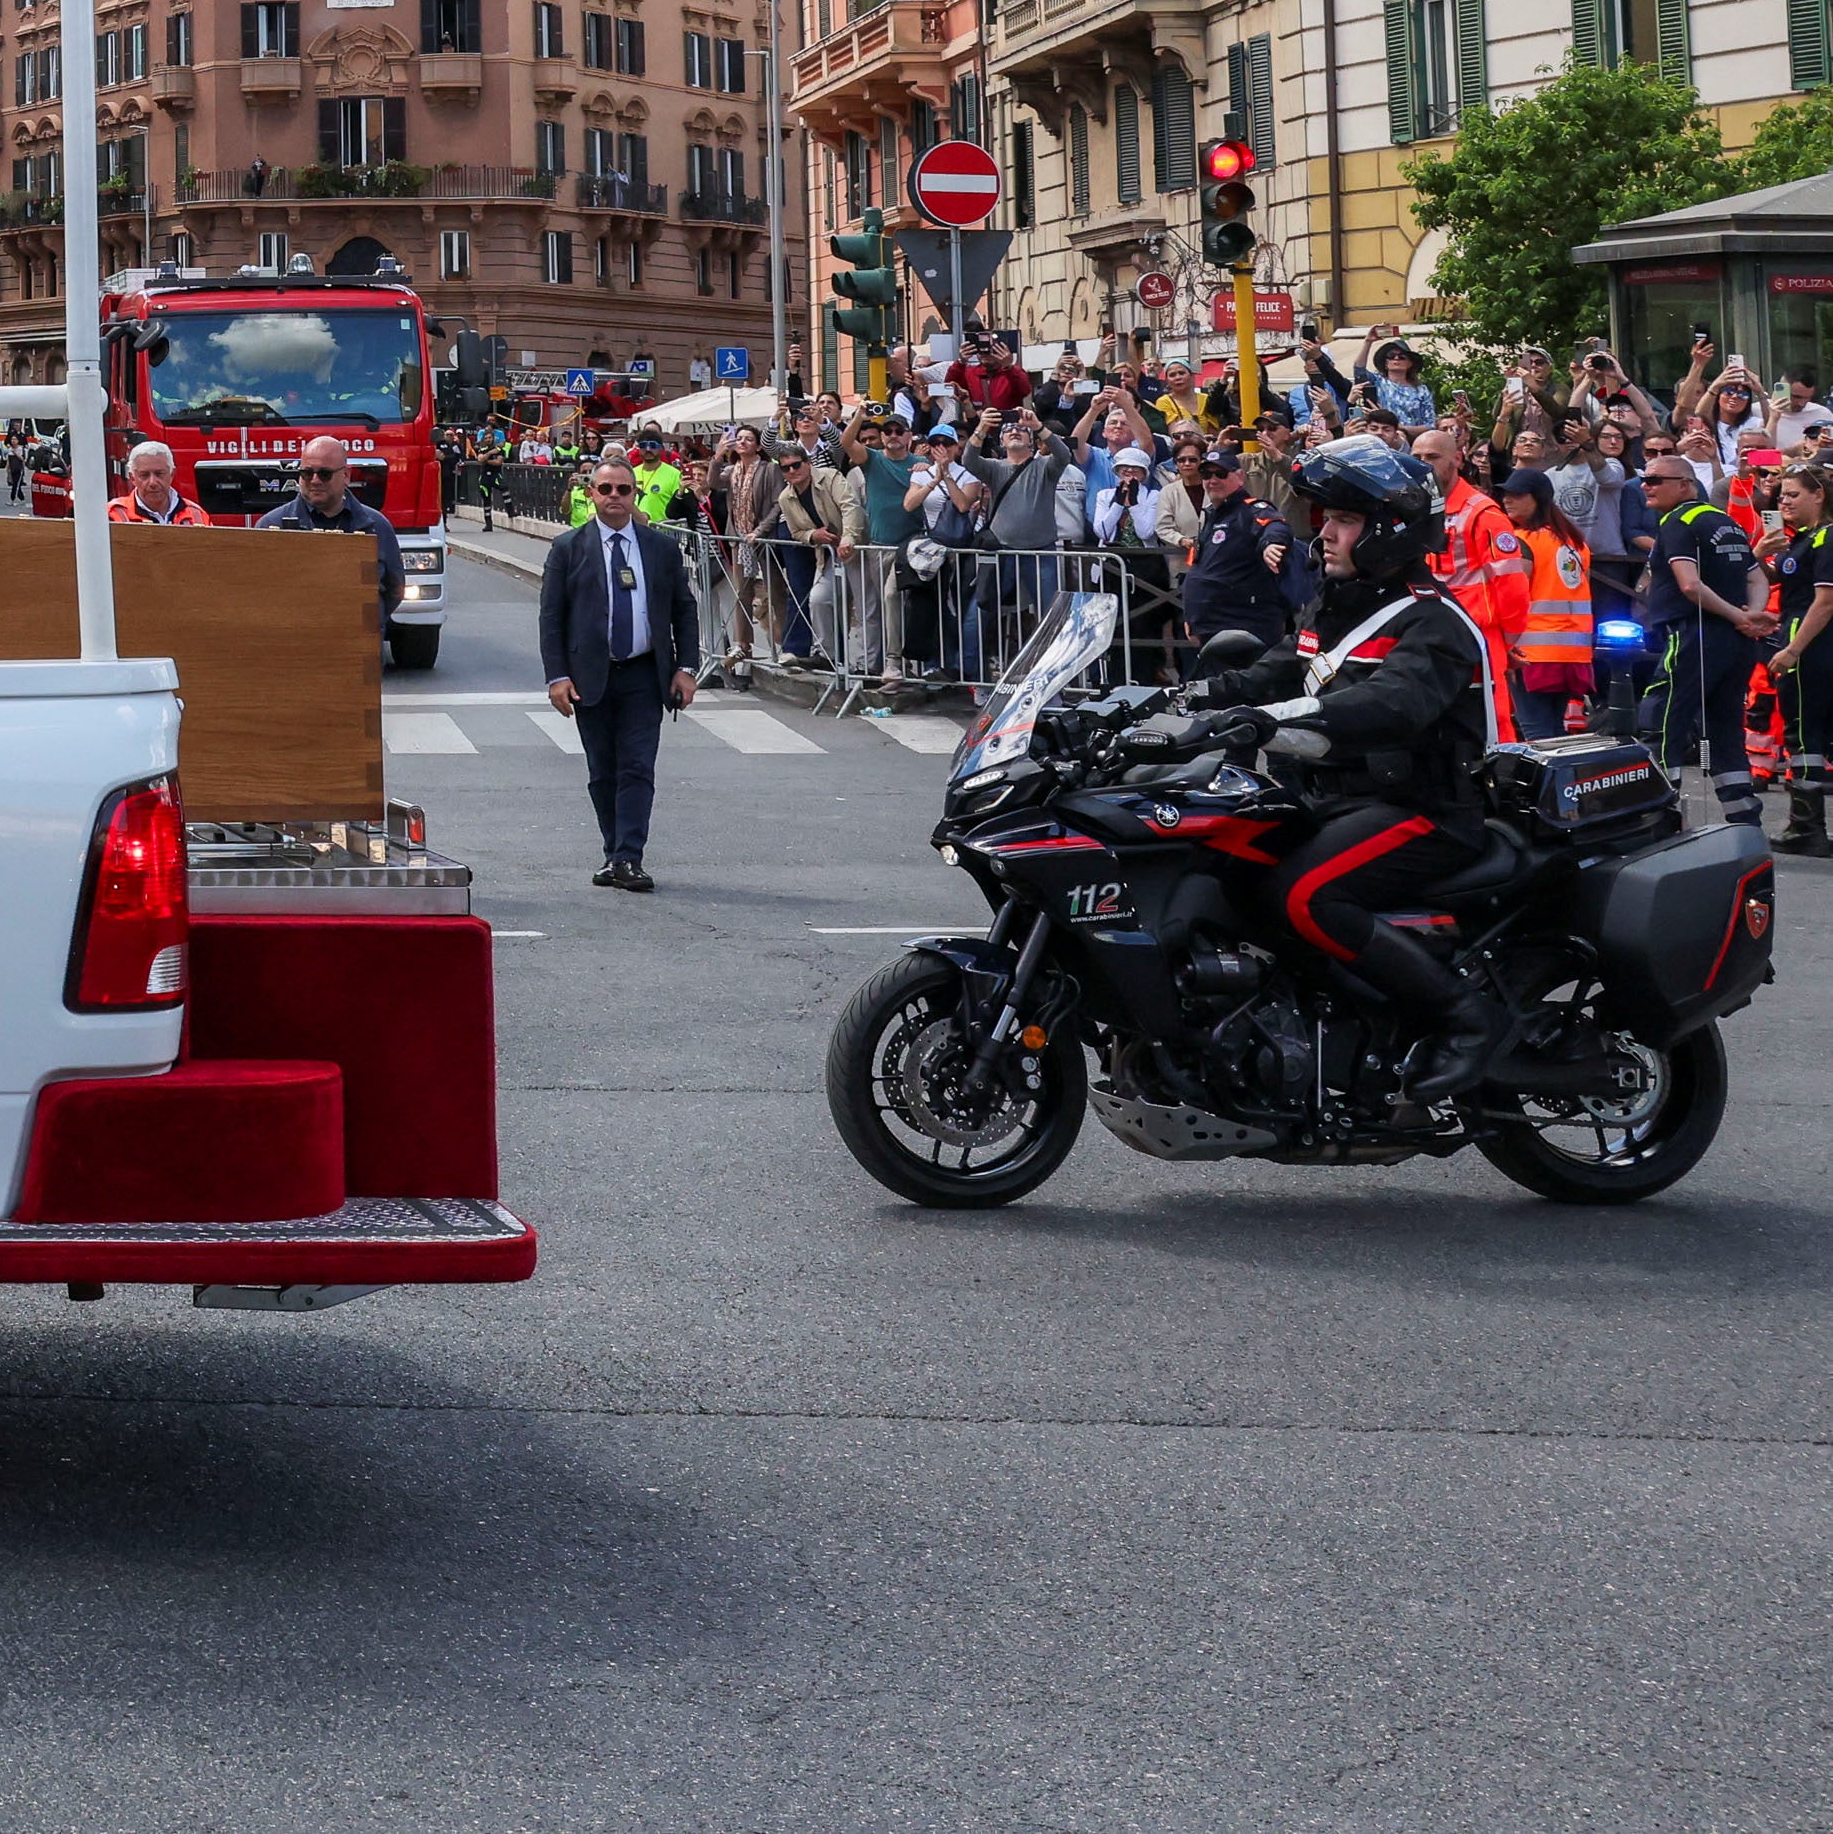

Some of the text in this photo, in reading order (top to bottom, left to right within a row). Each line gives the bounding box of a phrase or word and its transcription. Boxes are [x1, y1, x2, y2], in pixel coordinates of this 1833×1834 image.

[1788, 278, 1833, 289] POLIZIA
[1255, 301, 1281, 313] FELICE
[207, 440, 267, 454] VIGILI
[342, 438, 375, 453] OCO
[259, 479, 301, 493] MA
[996, 676, 1050, 696] ABINIERI
[1563, 767, 1650, 799] CARABINIERI
[1066, 882, 1123, 916] 112
[1069, 911, 1135, 924] www.carabinieri.it
